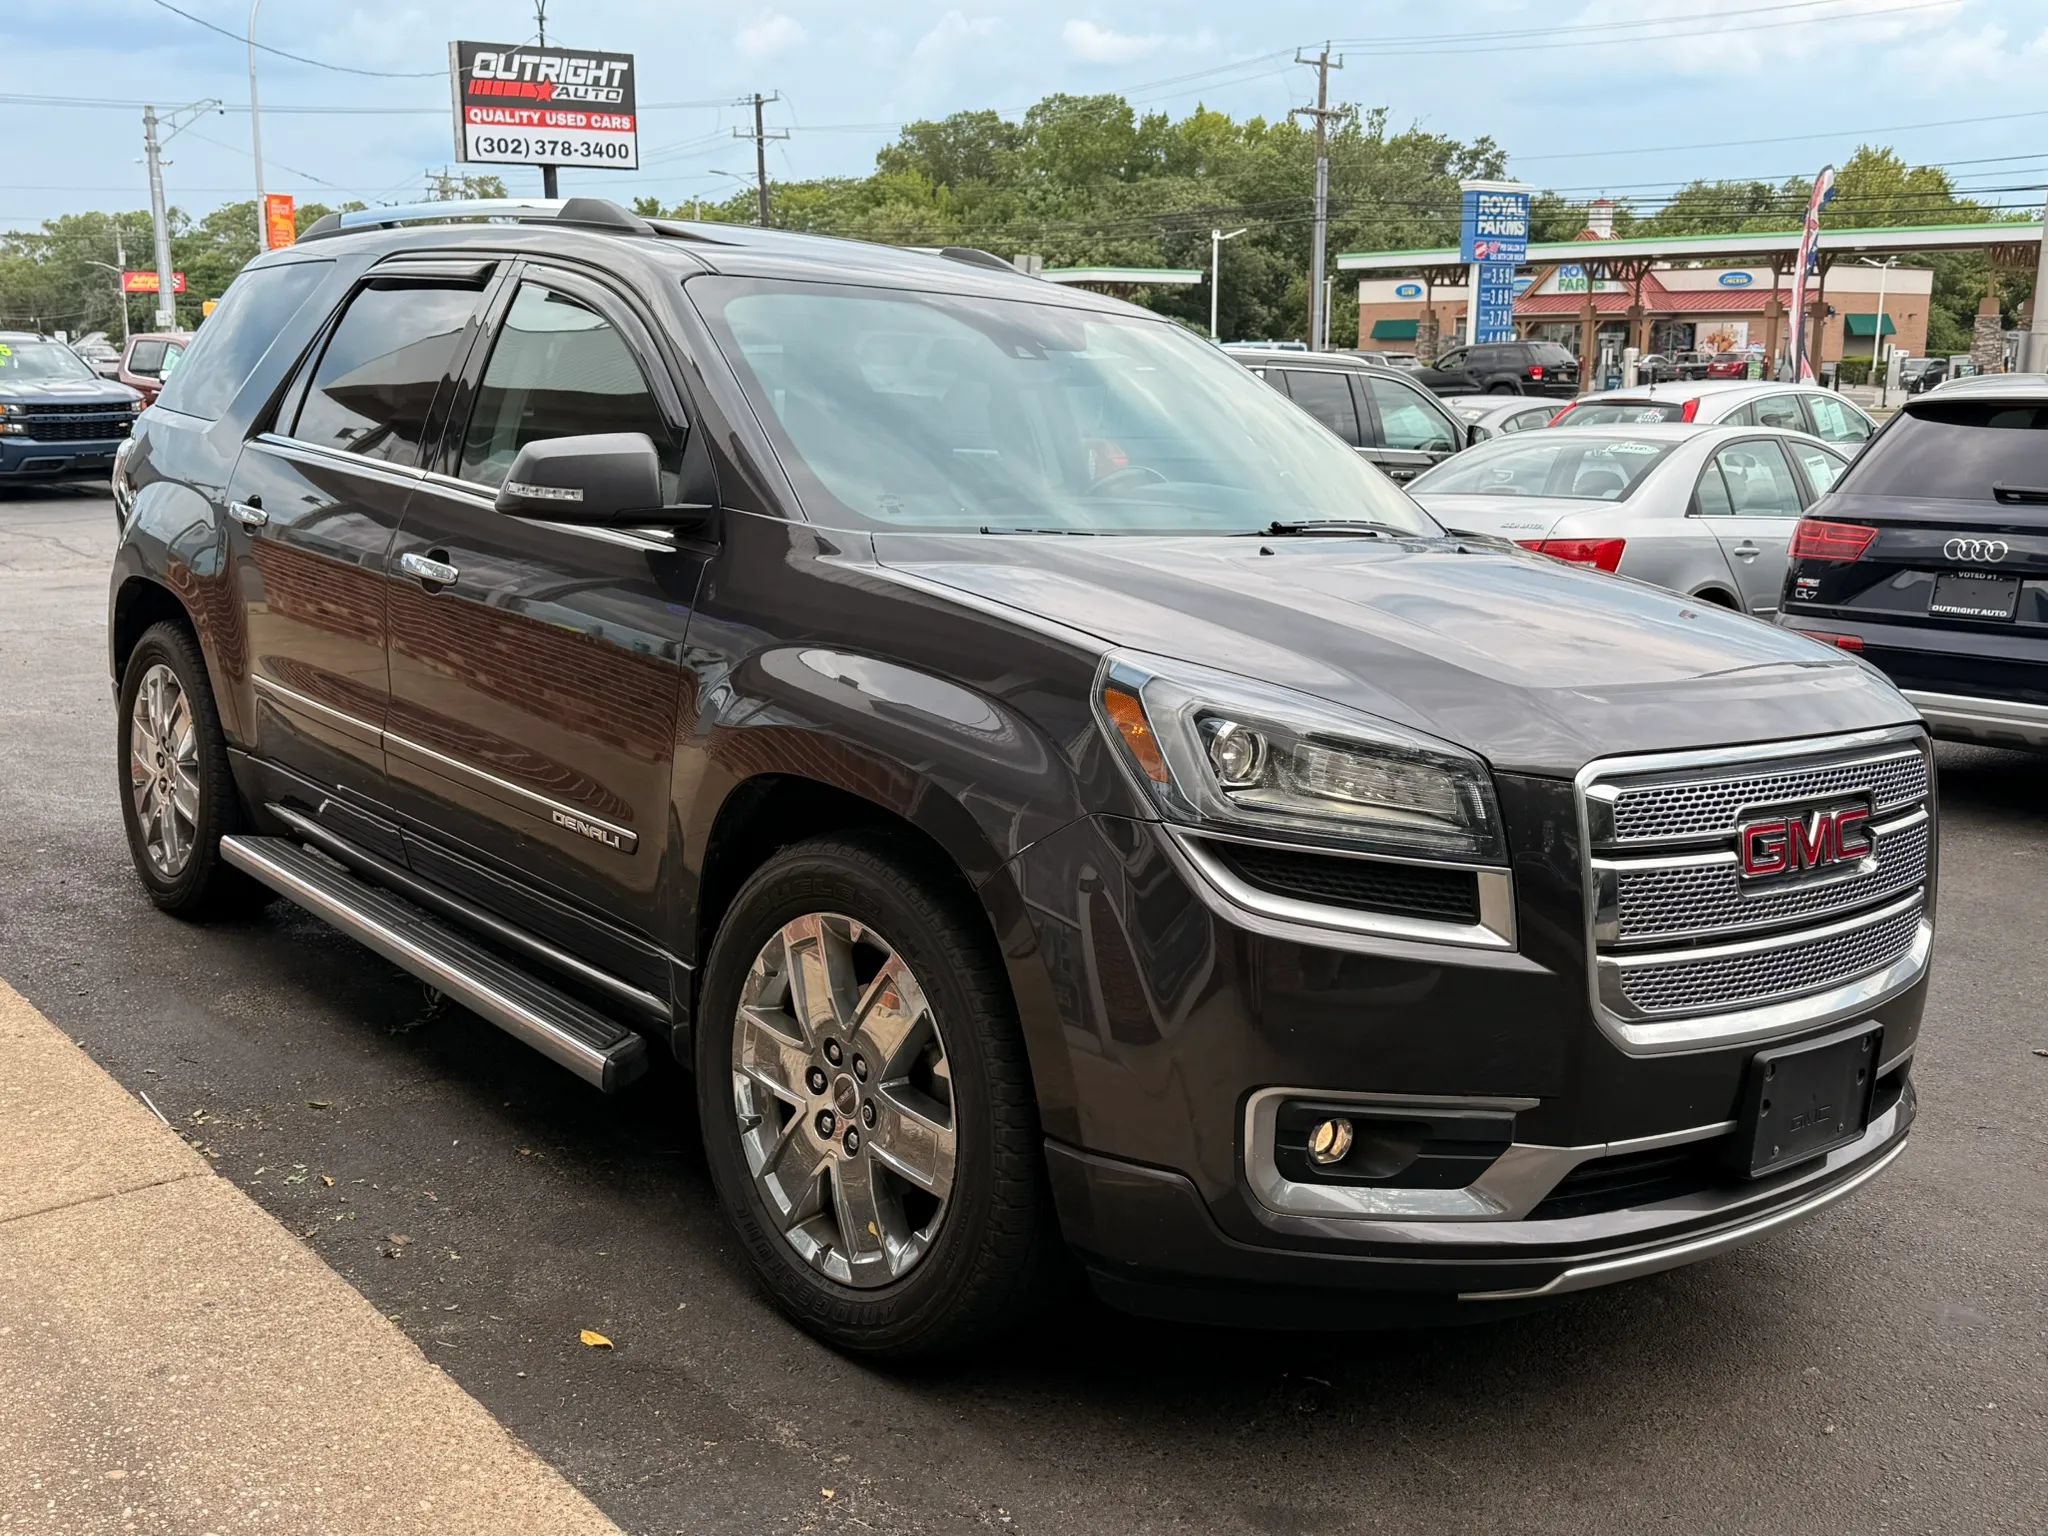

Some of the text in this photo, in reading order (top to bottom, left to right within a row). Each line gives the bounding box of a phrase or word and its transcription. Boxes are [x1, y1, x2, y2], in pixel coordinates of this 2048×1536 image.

[472, 52, 629, 87] OUTRIGHT
[555, 87, 622, 102] AUTO
[470, 108, 631, 130] QUALITY USED CARS
[475, 135, 629, 159] (302) 378-3400
[1479, 195, 1526, 216] ROYAL
[1477, 215, 1525, 236] FARMS
[1958, 571, 1986, 579] VOTED
[1795, 588, 1818, 600] Q7
[1932, 605, 2007, 617] OUTRIGHT AUTO
[552, 810, 620, 849] DENALI
[1741, 808, 1871, 877] GMC
